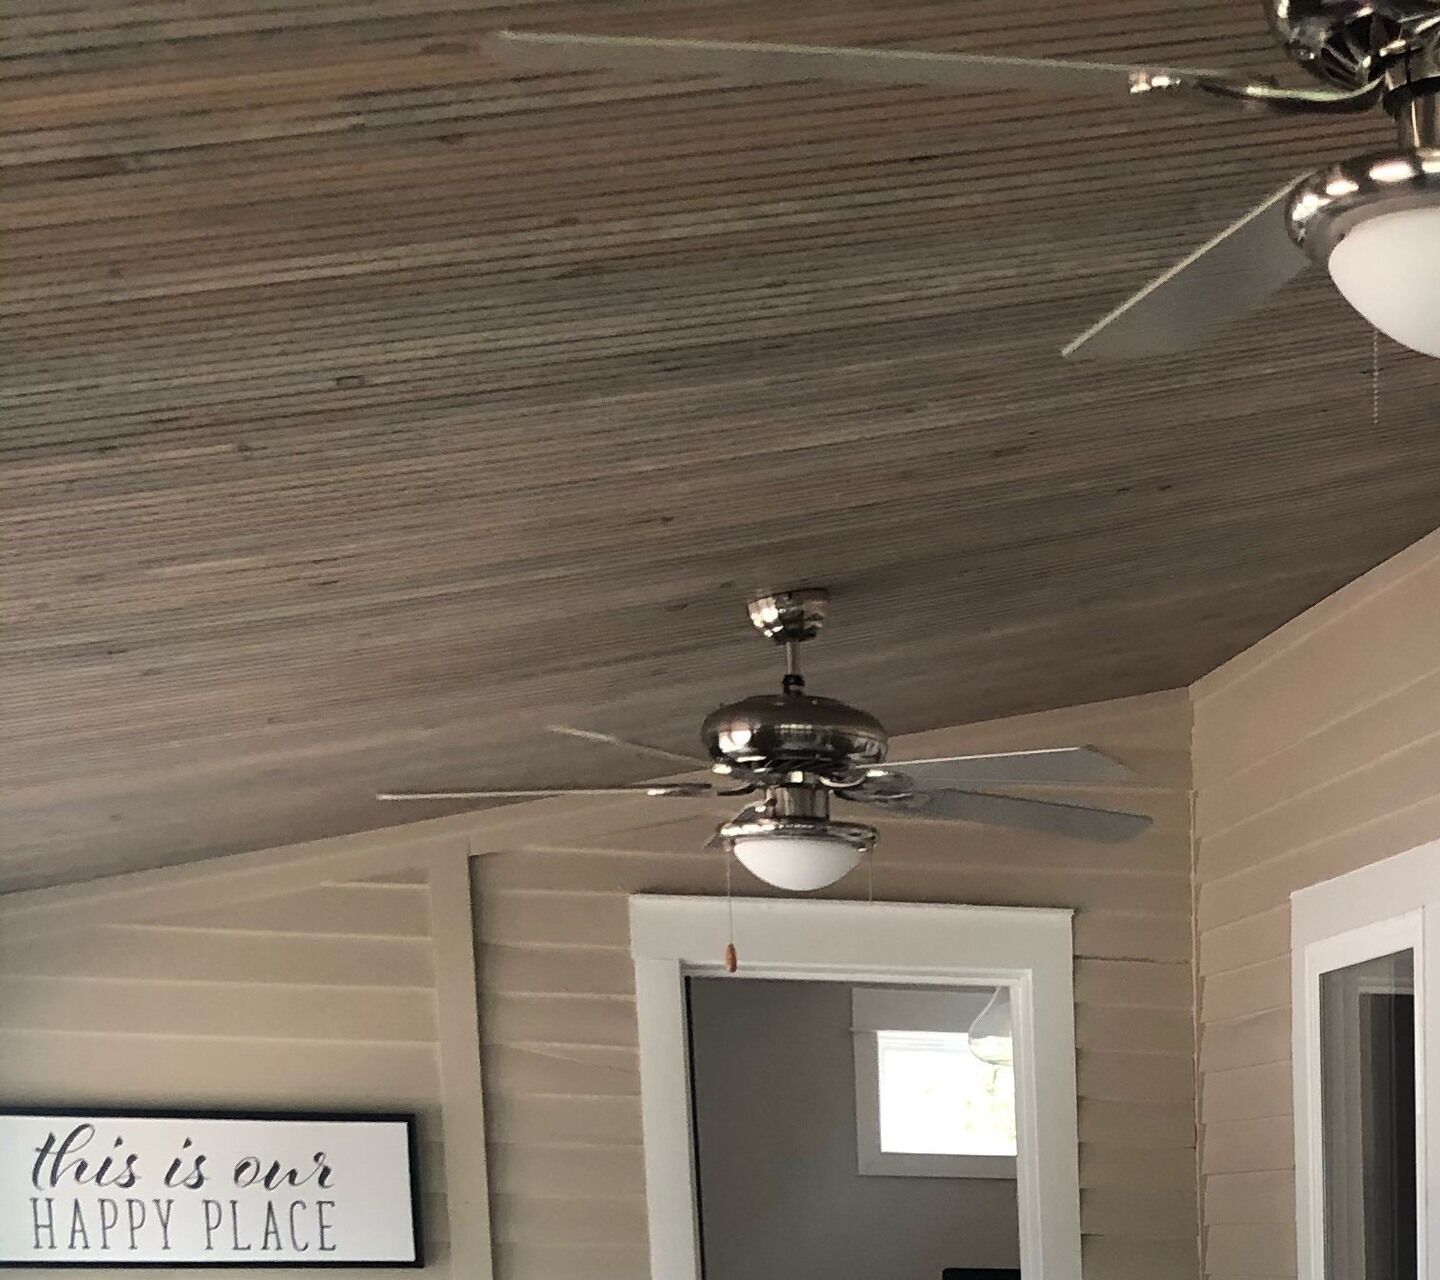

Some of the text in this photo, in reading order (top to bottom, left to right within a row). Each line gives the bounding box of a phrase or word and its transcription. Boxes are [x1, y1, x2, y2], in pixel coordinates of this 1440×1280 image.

[32, 1123, 334, 1191] this is our
[29, 1198, 337, 1252] HAPPY PLACE
